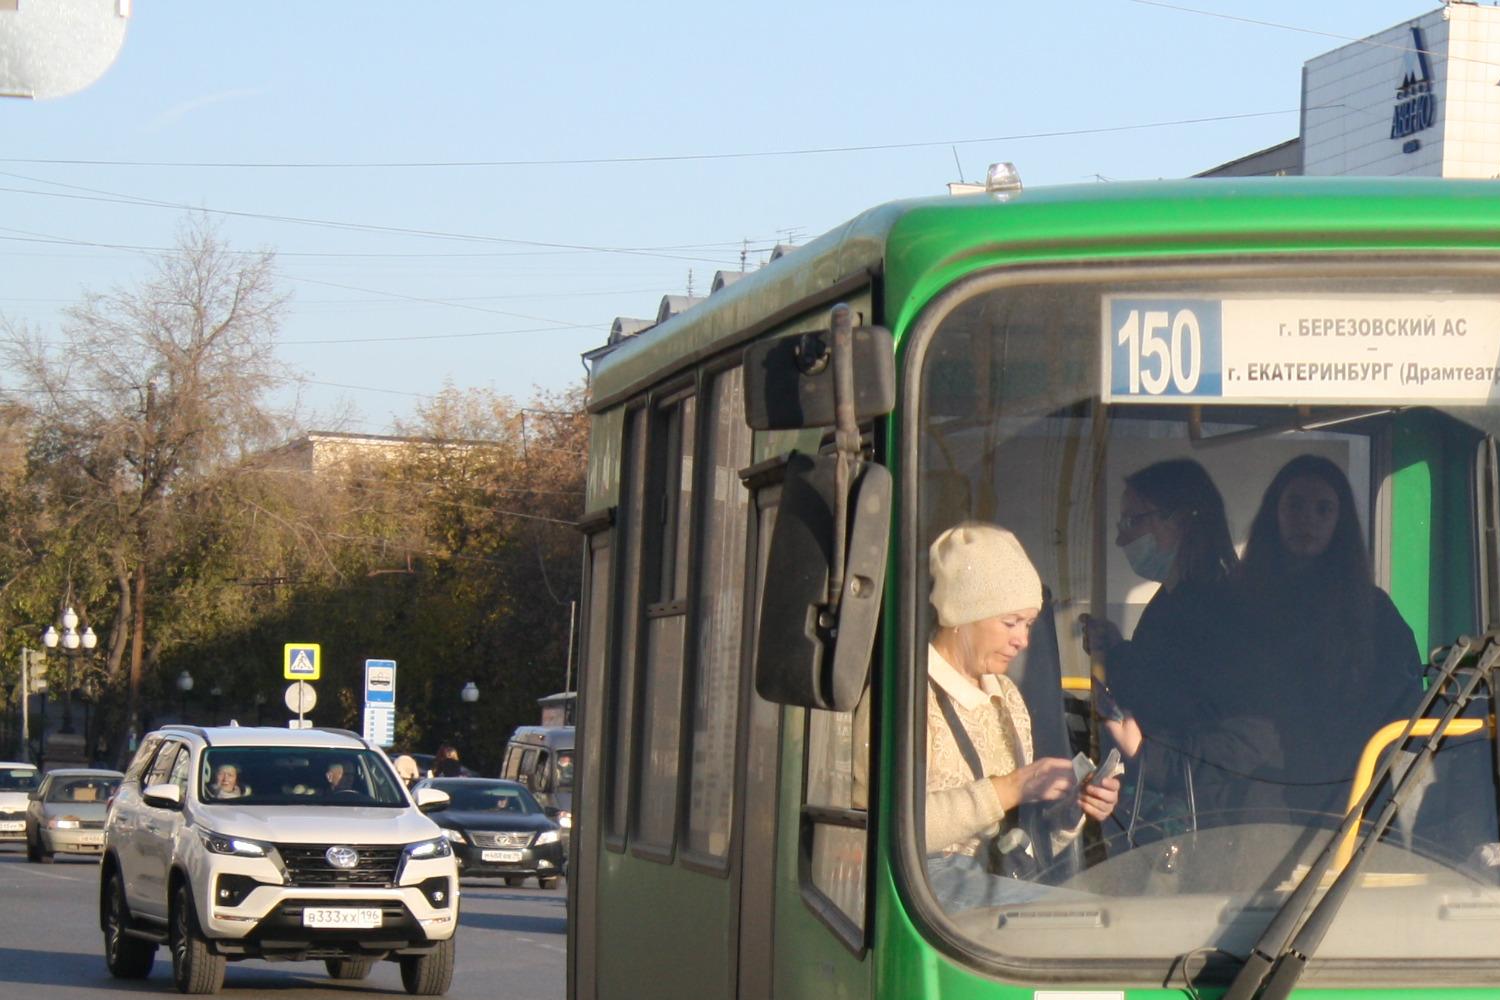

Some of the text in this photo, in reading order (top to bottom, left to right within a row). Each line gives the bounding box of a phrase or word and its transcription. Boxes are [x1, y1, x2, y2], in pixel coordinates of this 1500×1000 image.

[1279, 314, 1468, 337] г. БЕРЕЗОВСКИЙ АС
[1117, 308, 1202, 395] 150
[1227, 364, 1242, 382] г.
[1247, 362, 1394, 382] ЕКАТЕРИНБУРГ
[308, 910, 379, 923] В333ХХ 196
